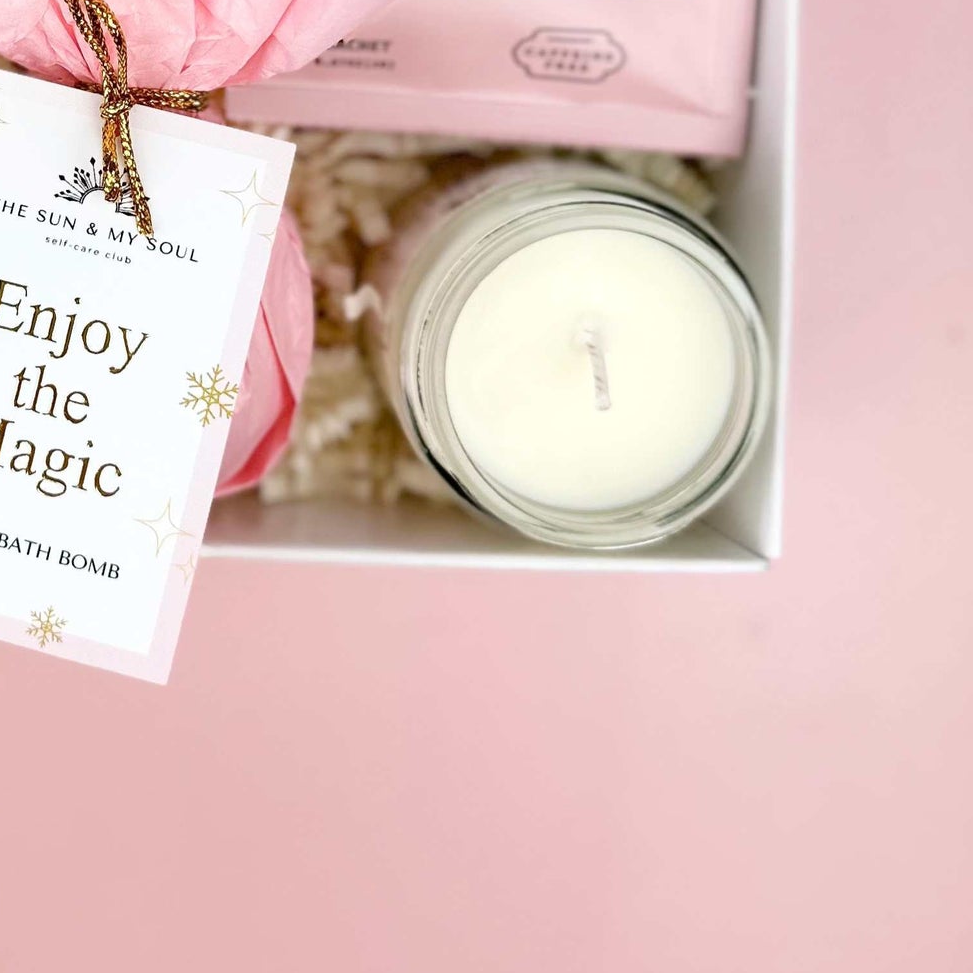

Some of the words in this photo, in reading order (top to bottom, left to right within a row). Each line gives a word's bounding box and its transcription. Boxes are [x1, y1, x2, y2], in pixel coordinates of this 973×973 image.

[36, 209, 77, 231] SUN
[86, 222, 98, 236] &
[108, 227, 140, 246] MY
[146, 237, 199, 263] SOUL
[45, 236, 100, 256] self-care
[105, 250, 132, 265] club
[12, 365, 91, 425] the
[59, 550, 121, 580] BOMB
